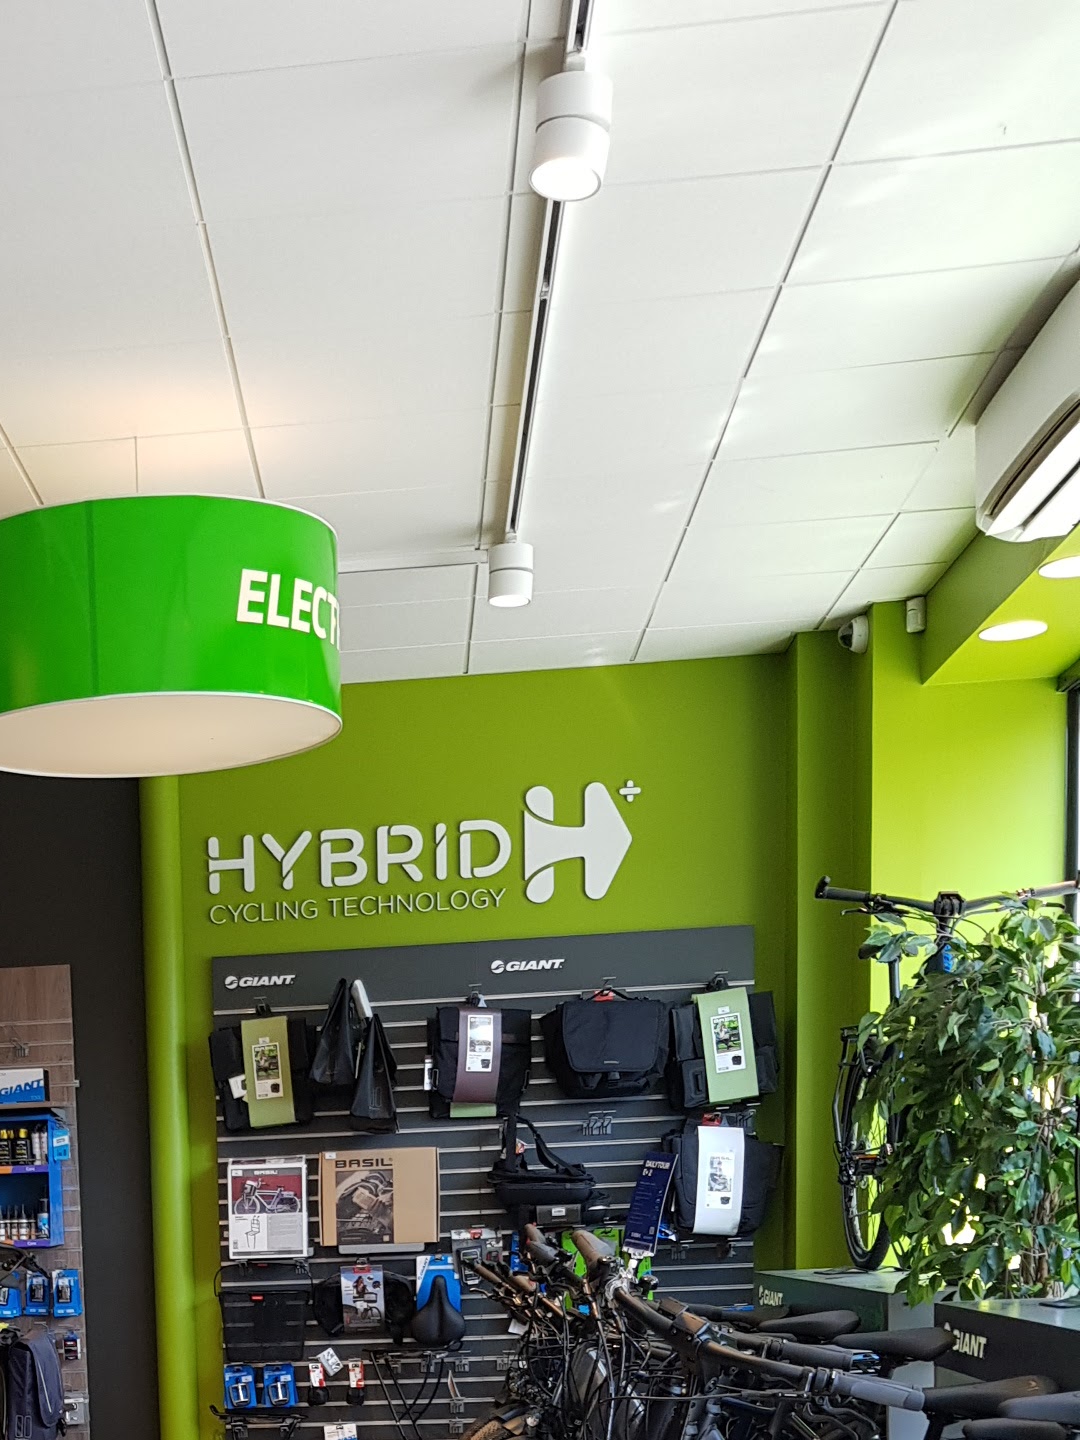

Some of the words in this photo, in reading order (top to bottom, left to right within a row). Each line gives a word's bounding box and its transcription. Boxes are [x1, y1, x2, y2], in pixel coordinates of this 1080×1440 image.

[208, 819, 512, 895] HYBRID
[209, 899, 318, 925] CYCLING
[328, 887, 507, 918] TECHNOLOGY
[506, 958, 565, 972] GIANT
[239, 974, 296, 988] GIANT
[0, 1079, 44, 1098] GIANT
[335, 1158, 393, 1169] BASIL
[763, 1290, 783, 1307] GIANT
[953, 1329, 987, 1359] GIANT
